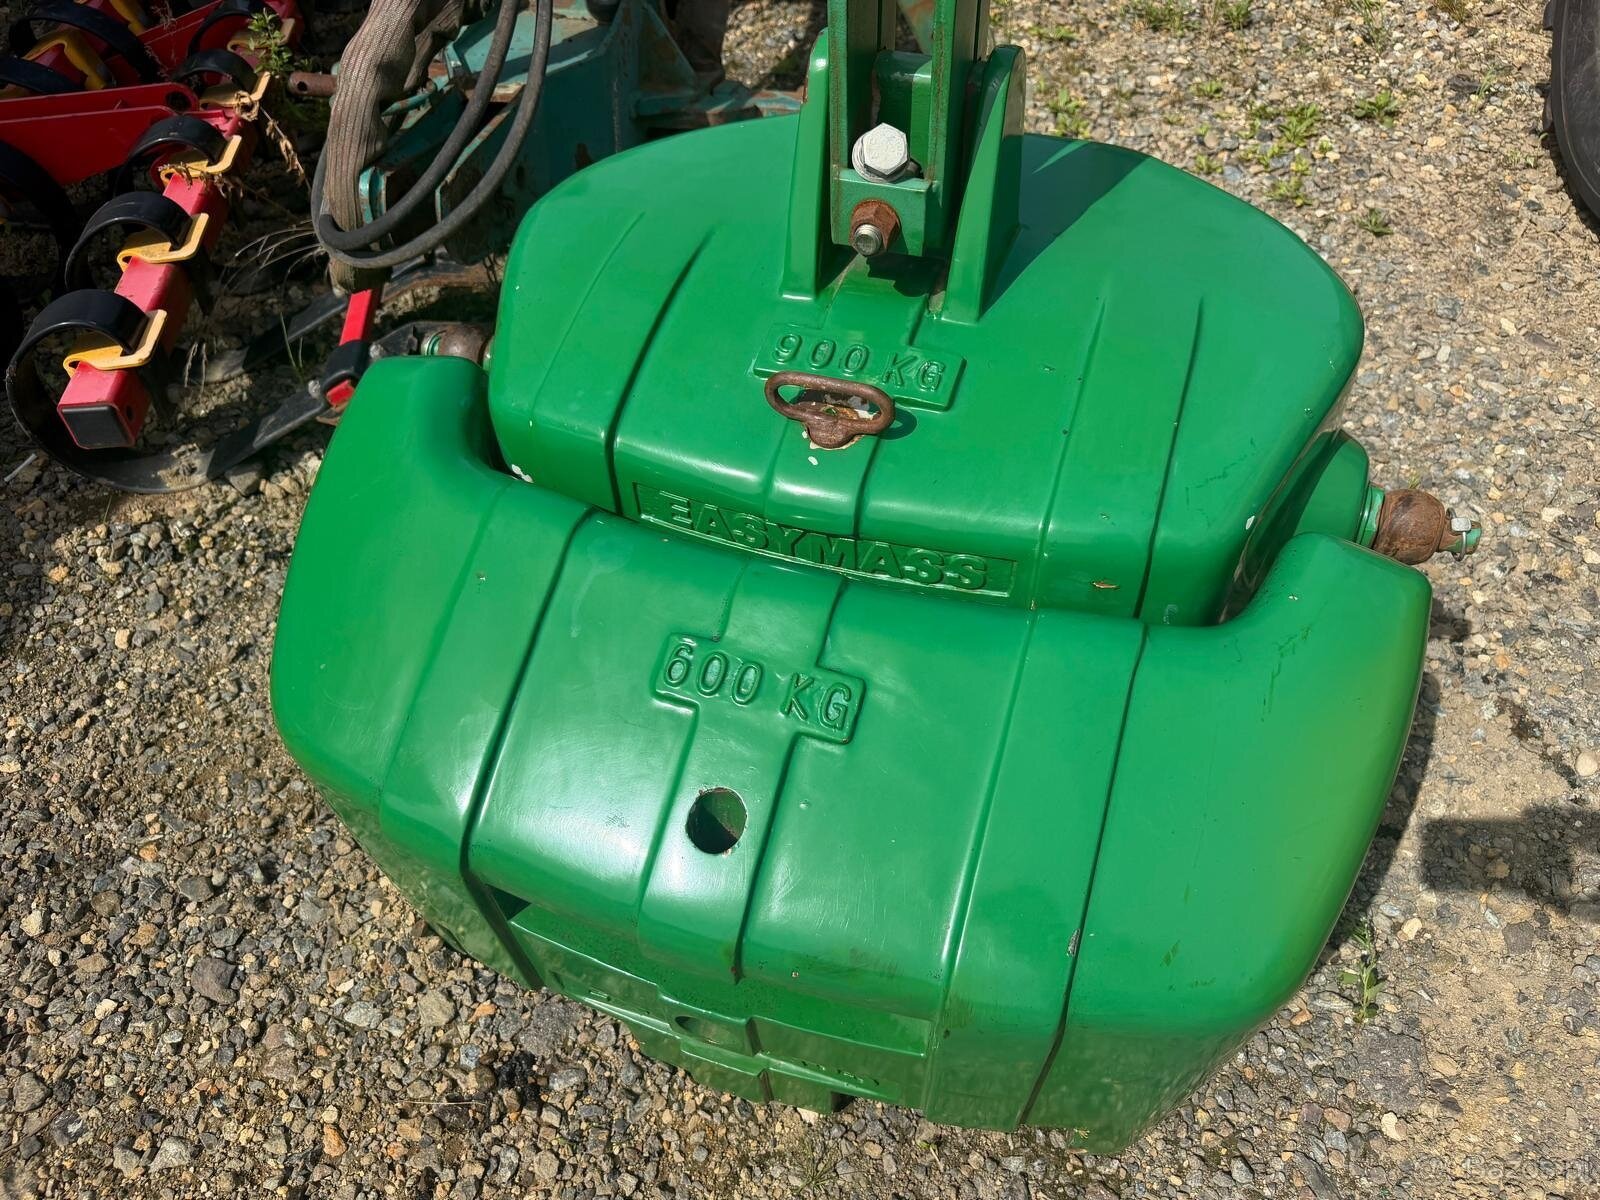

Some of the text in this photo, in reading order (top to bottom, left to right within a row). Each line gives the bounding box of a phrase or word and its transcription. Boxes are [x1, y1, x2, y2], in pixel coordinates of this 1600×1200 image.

[772, 333, 946, 392] 900 KG
[657, 489, 990, 588] EASYMASS
[663, 642, 852, 730] 600 KG
